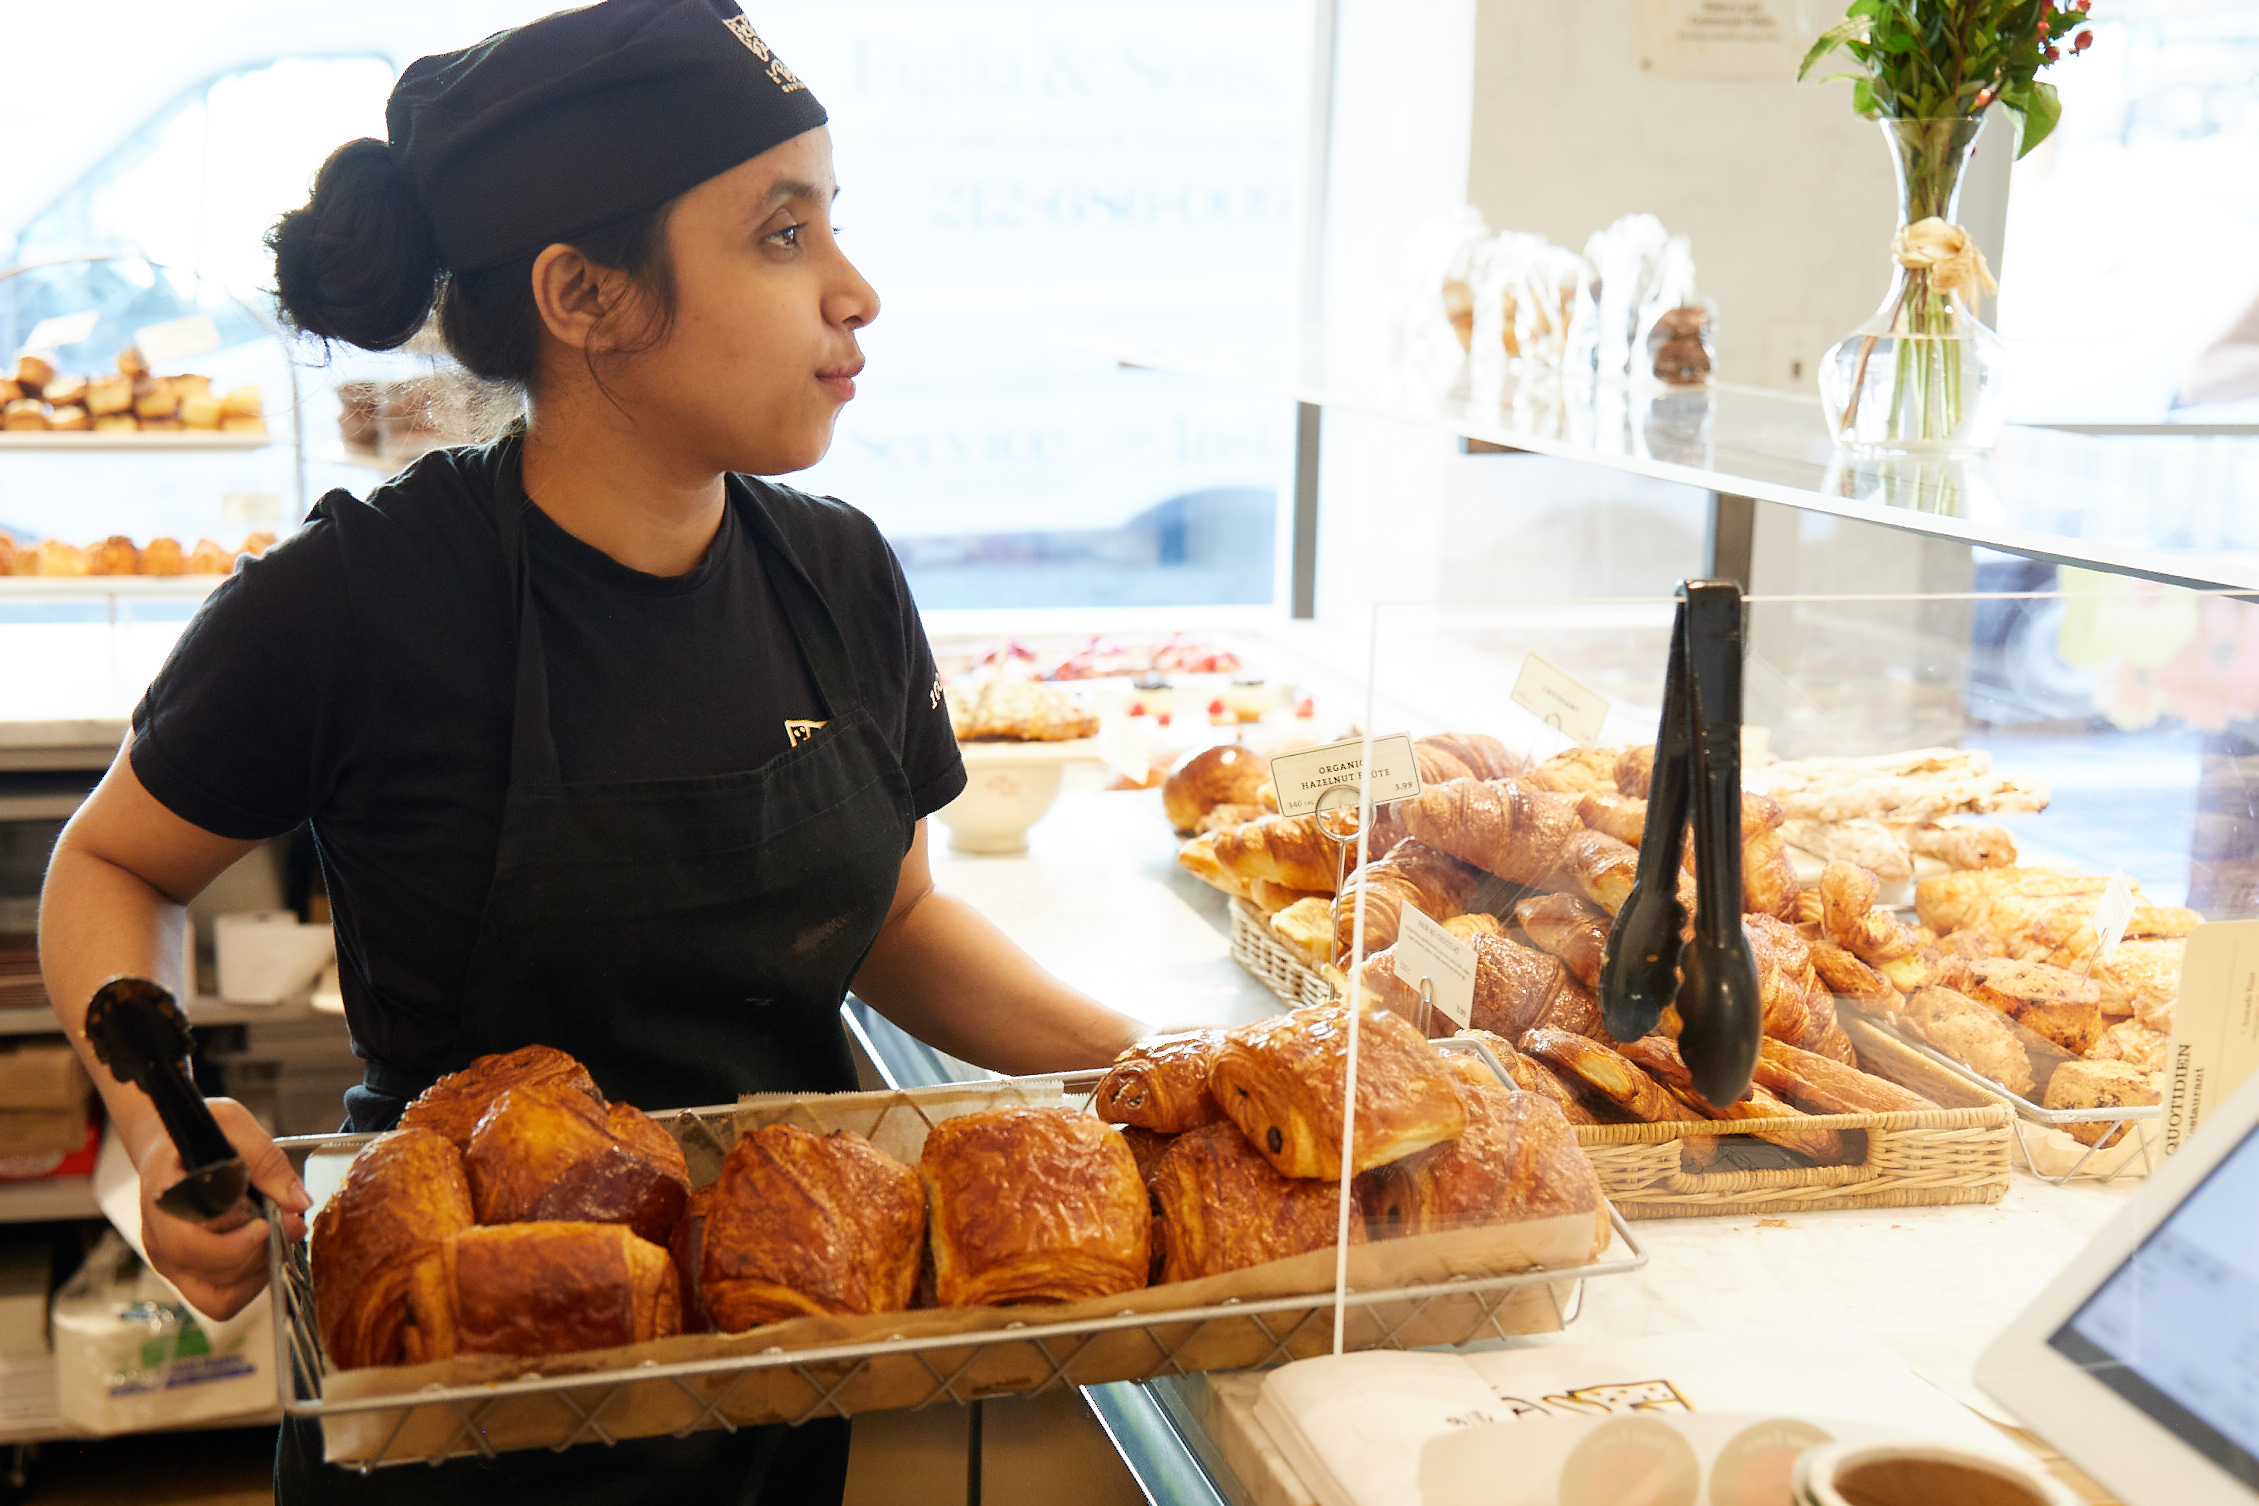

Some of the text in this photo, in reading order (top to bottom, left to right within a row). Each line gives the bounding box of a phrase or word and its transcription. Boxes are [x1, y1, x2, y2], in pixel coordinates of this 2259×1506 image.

[930, 179, 1292, 230] 212-686-009
[1301, 773, 1357, 790] HAZELNUT
[1395, 781, 1414, 791] 3.99
[2165, 1043, 2192, 1156] QUOTIDIEN
[2186, 1066, 2205, 1144] estaurant
